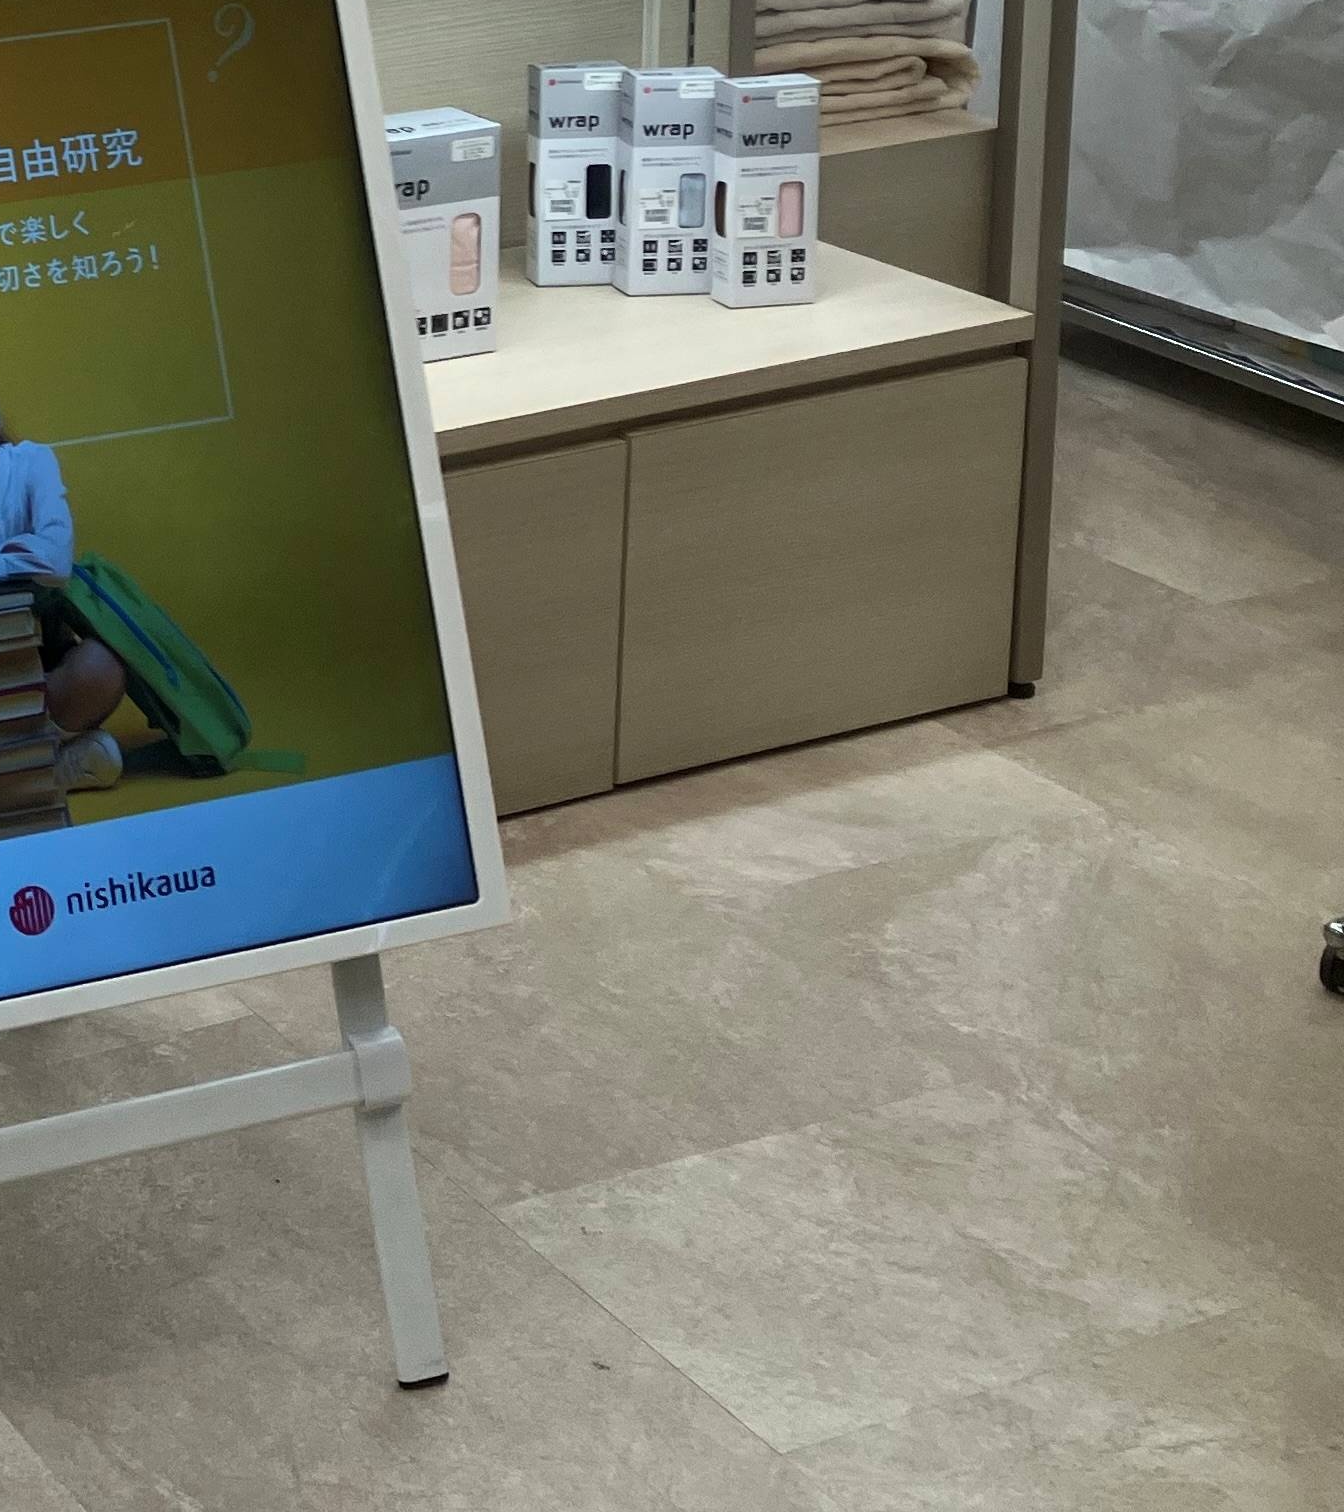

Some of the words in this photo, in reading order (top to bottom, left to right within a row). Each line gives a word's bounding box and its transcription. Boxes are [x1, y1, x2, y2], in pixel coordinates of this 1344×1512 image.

[549, 114, 601, 132] wrap
[642, 122, 695, 140] wrap
[742, 131, 793, 149] wrap
[67, 866, 216, 914] nishikawa
